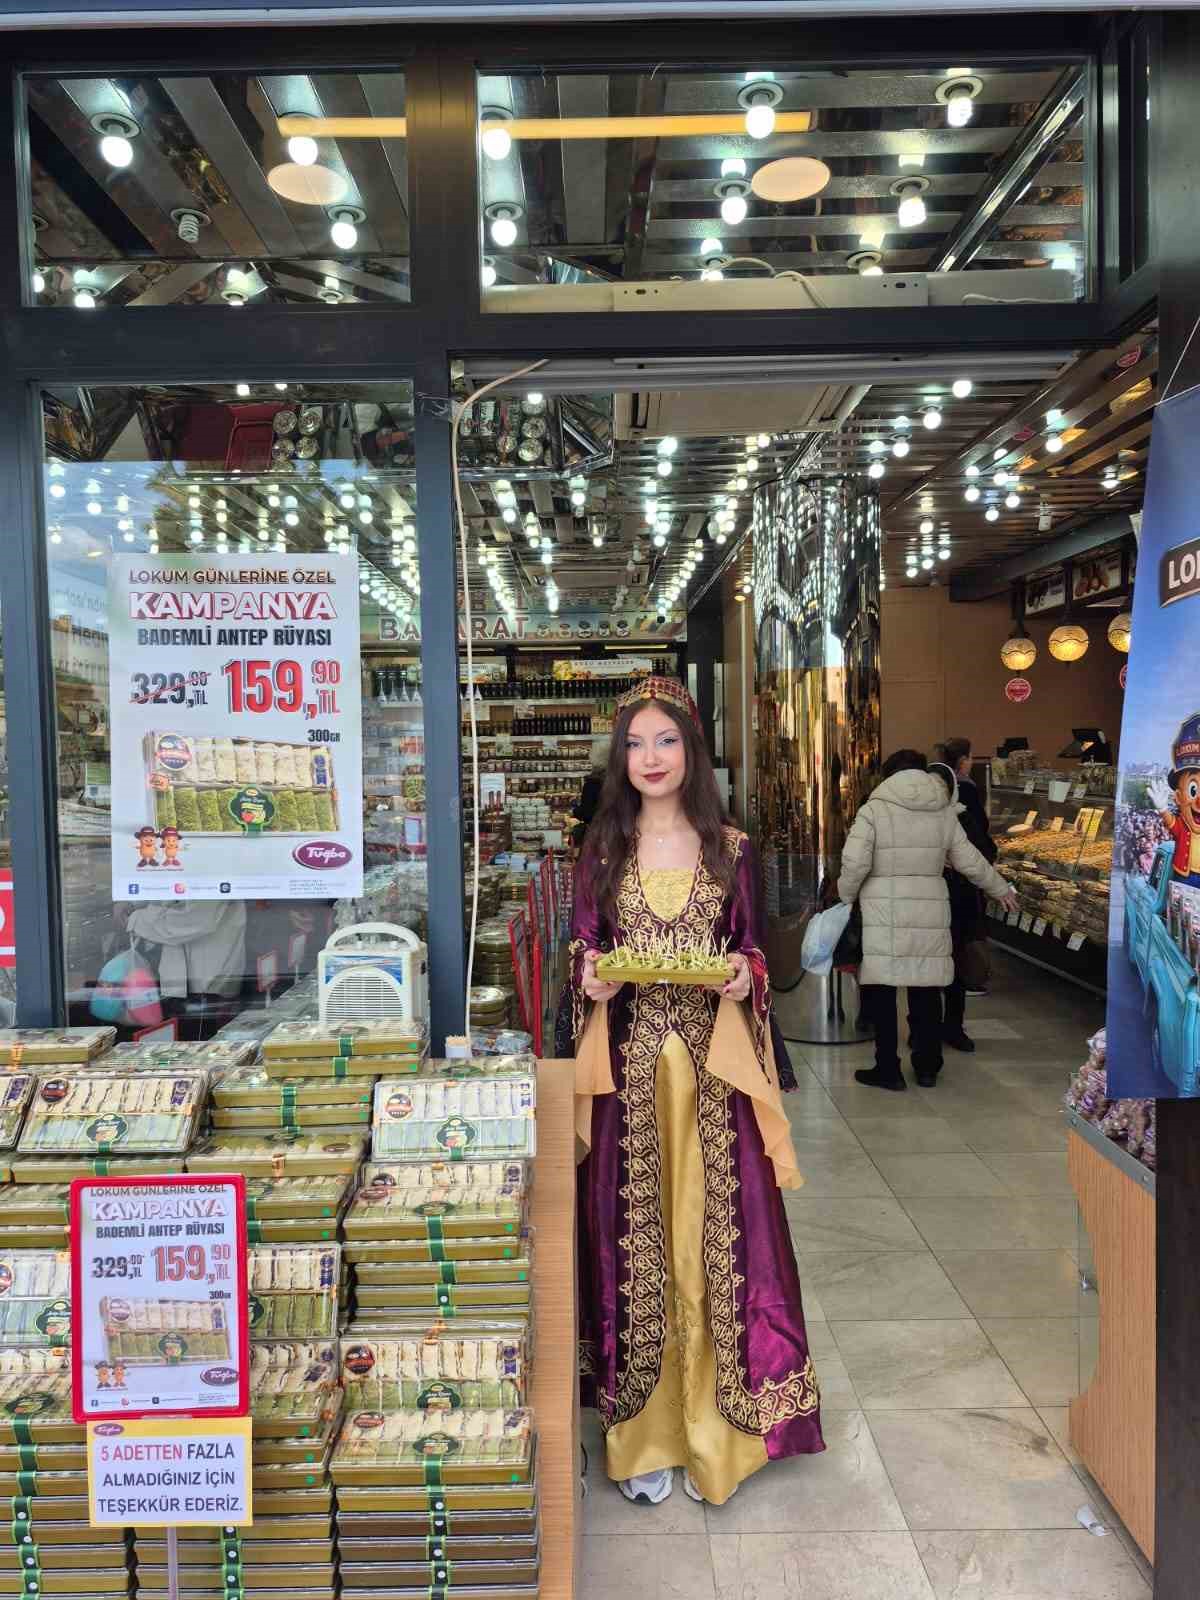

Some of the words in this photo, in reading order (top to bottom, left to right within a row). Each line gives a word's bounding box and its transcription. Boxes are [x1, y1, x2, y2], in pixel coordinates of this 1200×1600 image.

[129, 570, 188, 585] LOKUM
[193, 567, 289, 585] GÜNLERİNE
[292, 567, 336, 585] ÖZEL
[128, 592, 337, 620] KAMPANYA
[138, 625, 211, 646] BADEMLİ
[216, 628, 268, 646] ANTEP
[273, 625, 332, 646] RÜYASI
[308, 729, 341, 743] 300GR
[90, 1187, 131, 1198] LOKUM
[92, 1199, 228, 1222] KAMPANYA
[96, 1222, 145, 1239] BADEMLİ
[148, 1224, 183, 1237] ANTEP
[186, 1222, 225, 1236] RÜYASI
[101, 1446, 109, 1461] 5
[112, 1444, 183, 1461] ADETTEN
[187, 1442, 235, 1460] FAZLA
[103, 1468, 201, 1487] ALMADIĞINIZ
[205, 1468, 235, 1488] İÇİN
[98, 1494, 180, 1516] TEŞEKKÜR
[185, 1493, 243, 1512] EDERİZ.
